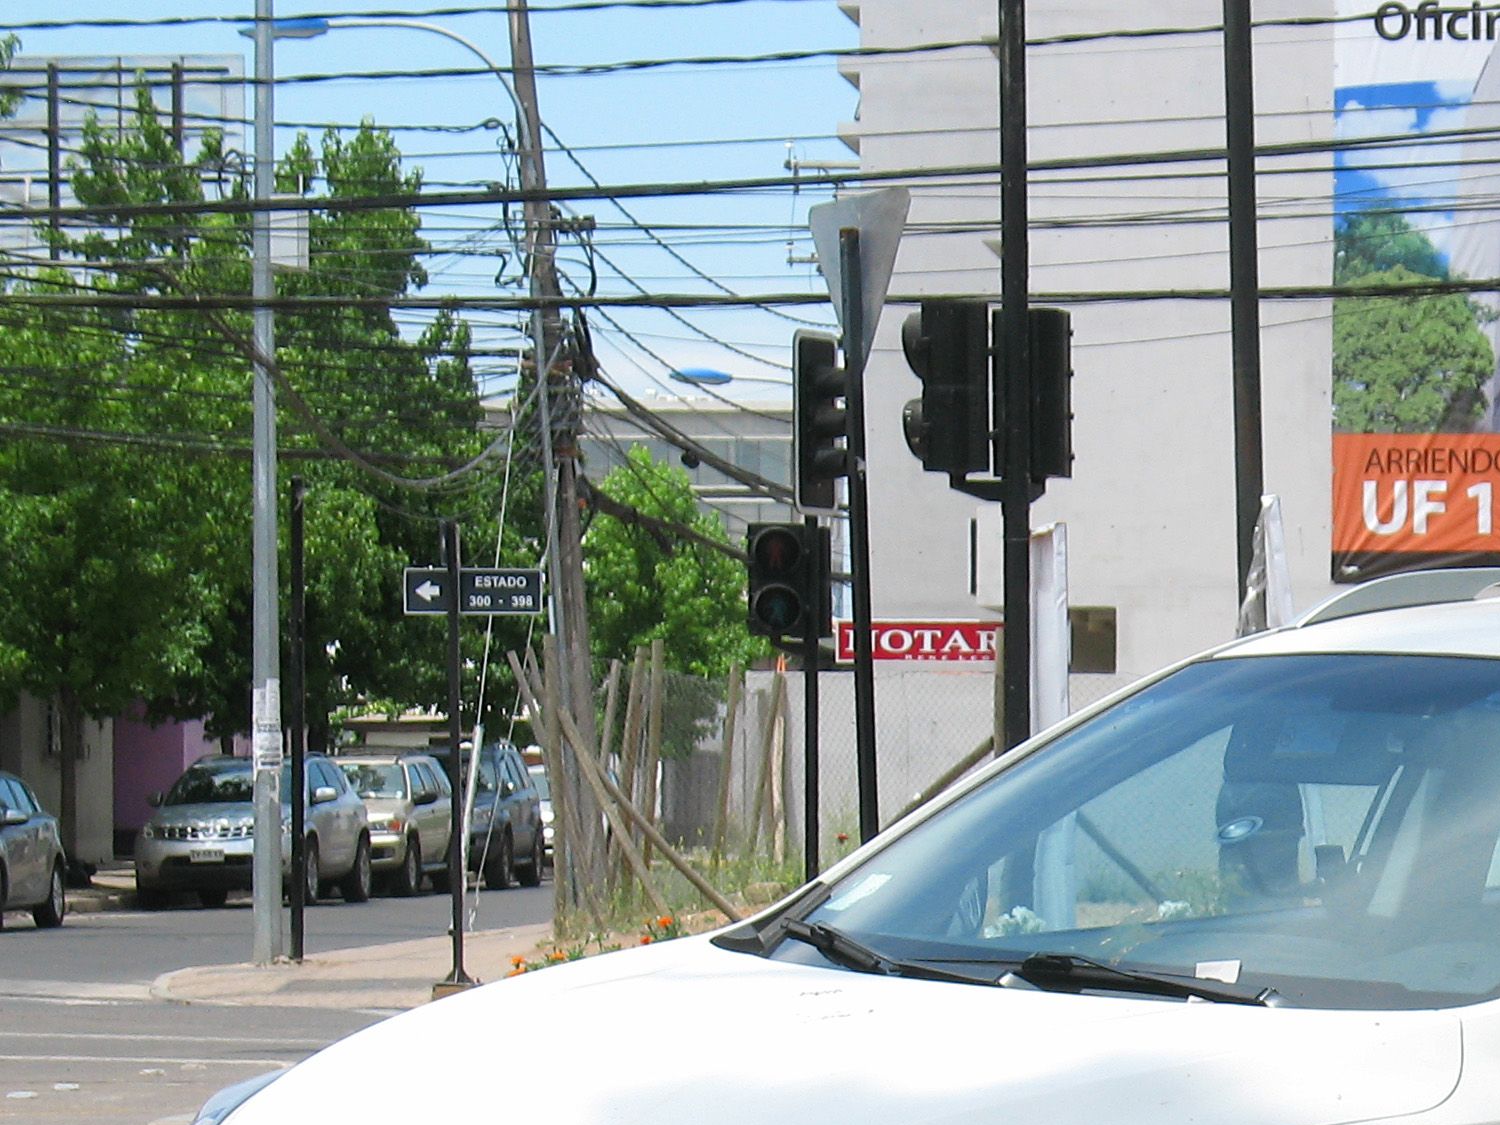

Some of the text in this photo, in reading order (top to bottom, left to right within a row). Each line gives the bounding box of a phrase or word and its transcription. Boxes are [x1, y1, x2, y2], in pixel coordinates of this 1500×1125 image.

[1362, 479, 1448, 537] UF
[474, 575, 528, 588] ESTADO
[469, 595, 492, 607] 300
[511, 595, 533, 607] 398
